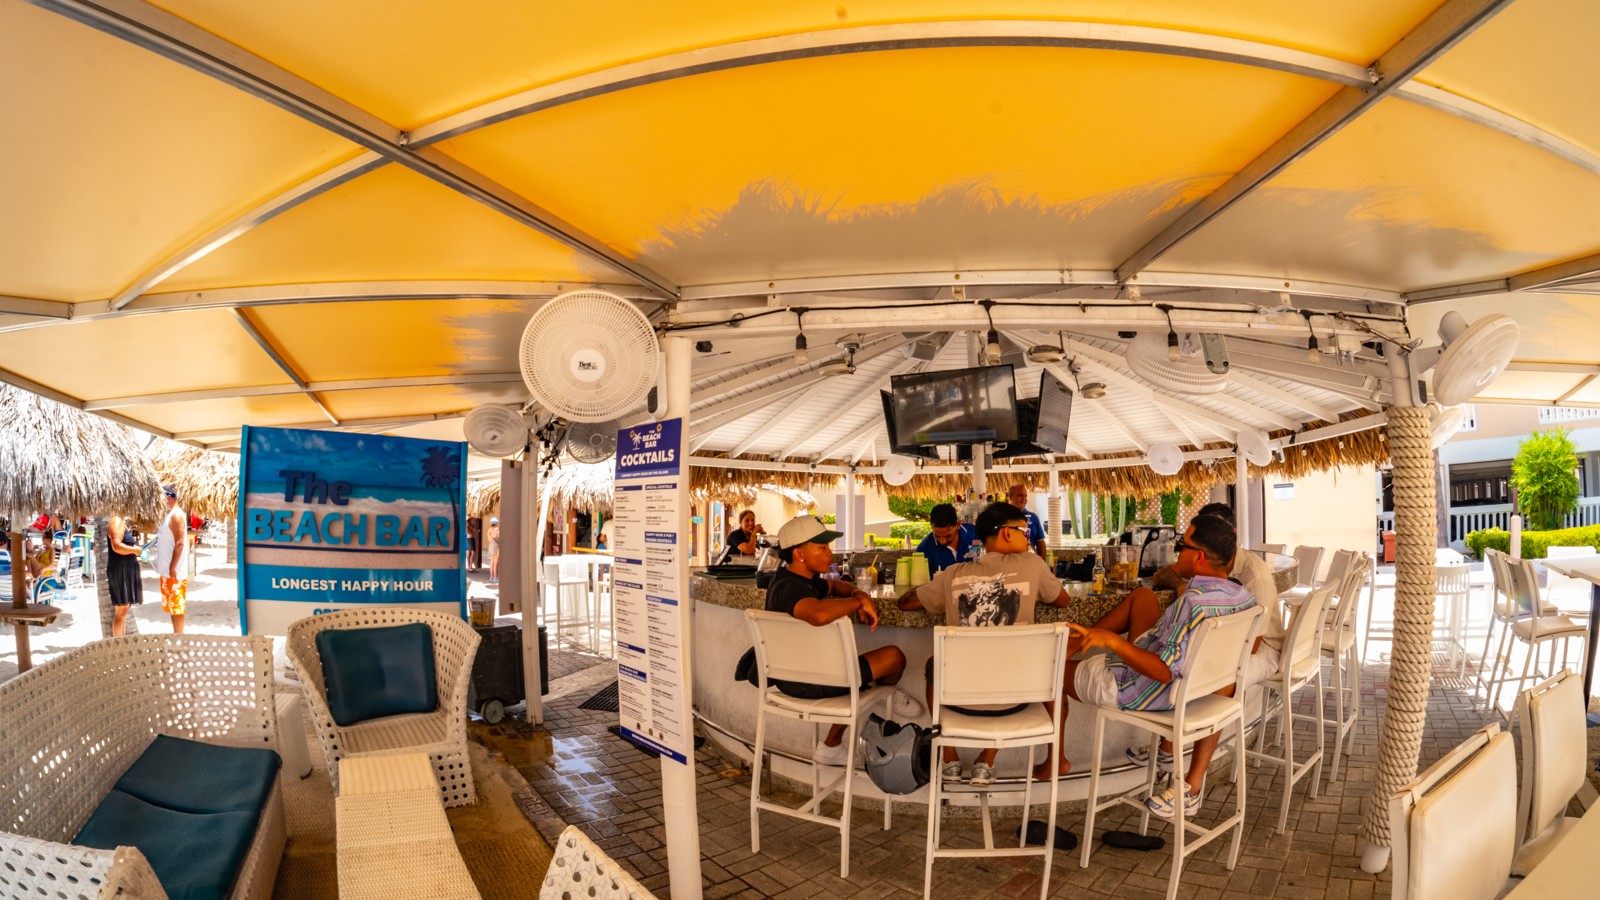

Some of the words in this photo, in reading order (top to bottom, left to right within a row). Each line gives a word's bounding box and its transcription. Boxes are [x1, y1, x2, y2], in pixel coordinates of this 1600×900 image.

[642, 433, 661, 442] BEACH
[621, 449, 674, 466] COCKTAILS
[279, 469, 352, 506] The
[247, 507, 368, 545] BEACH
[376, 514, 450, 547] BAR
[272, 577, 337, 591] LONGEST
[342, 580, 389, 591] HAPPY
[394, 580, 434, 591] HOUR
